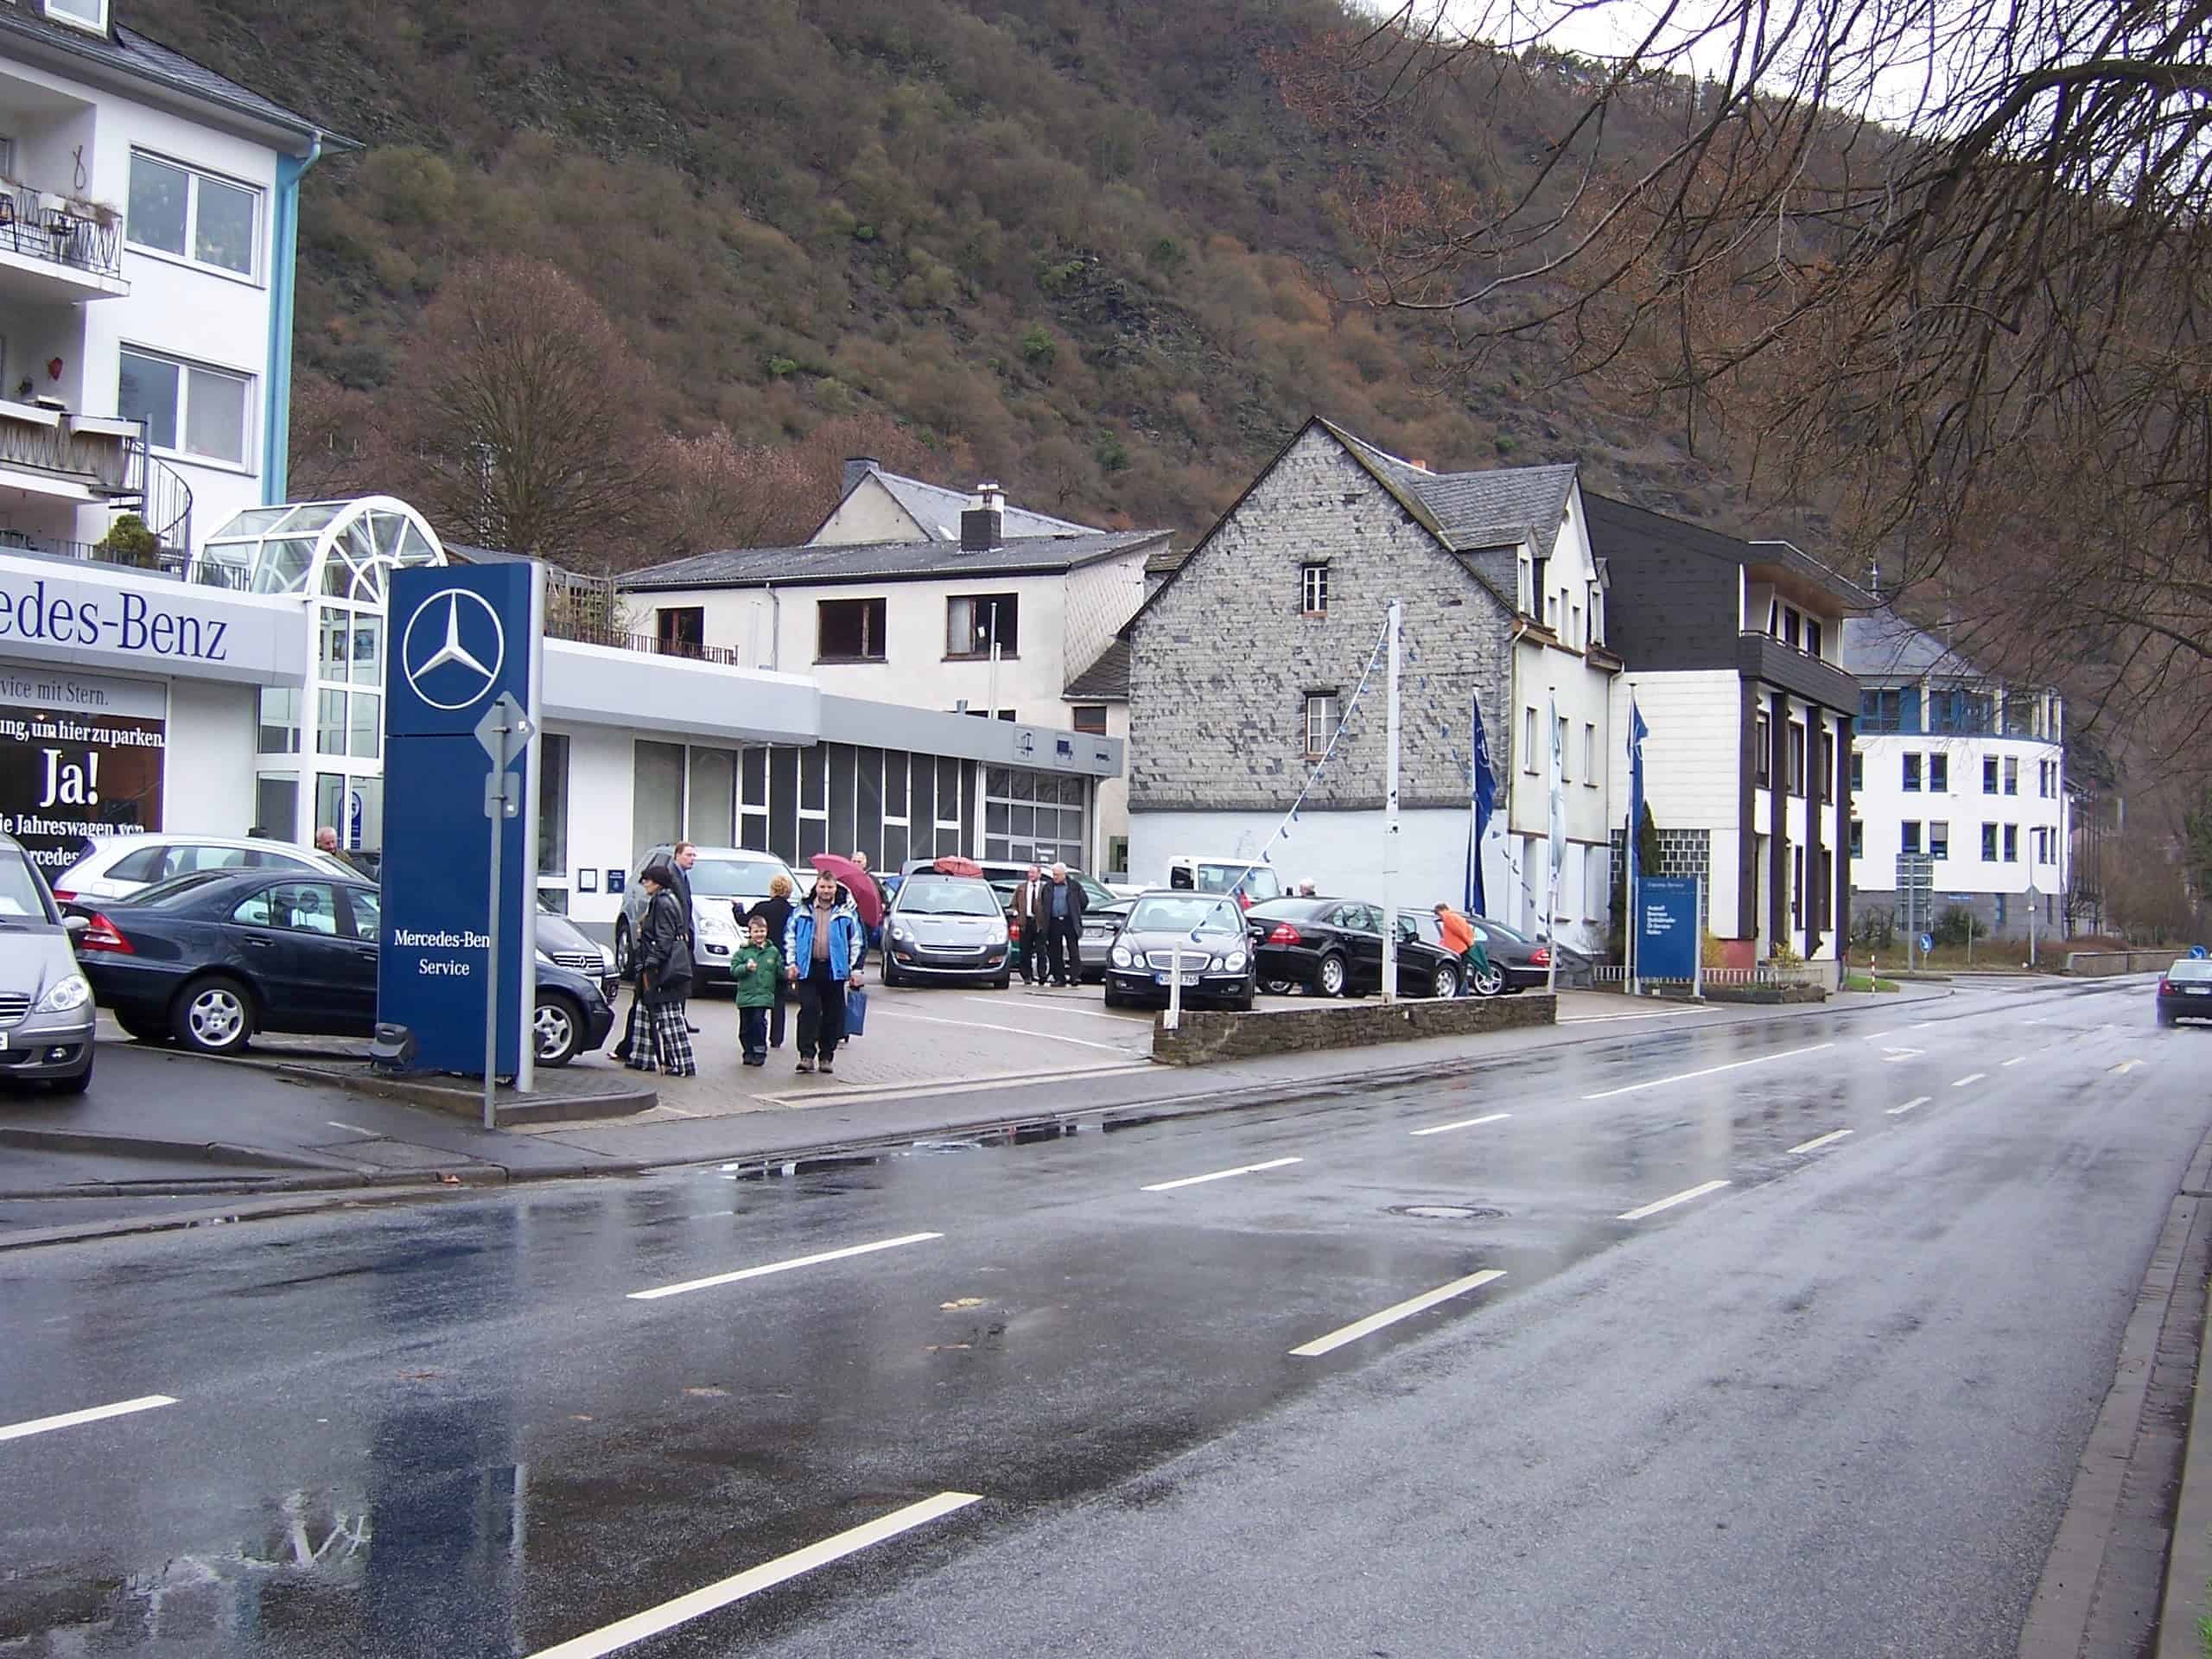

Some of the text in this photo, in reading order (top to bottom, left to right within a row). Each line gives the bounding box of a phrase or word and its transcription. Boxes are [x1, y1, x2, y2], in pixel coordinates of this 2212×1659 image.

[38, 680, 62, 701] mit
[66, 682, 109, 706] Stern.
[31, 721, 57, 739] um
[59, 720, 91, 741] hier
[92, 728, 110, 744] zu
[111, 728, 165, 748] parken.
[40, 748, 99, 808] Ja!
[16, 814, 114, 837] Jahreswagen
[394, 929, 490, 948] Mercedes-Ben
[419, 958, 470, 976] Service
